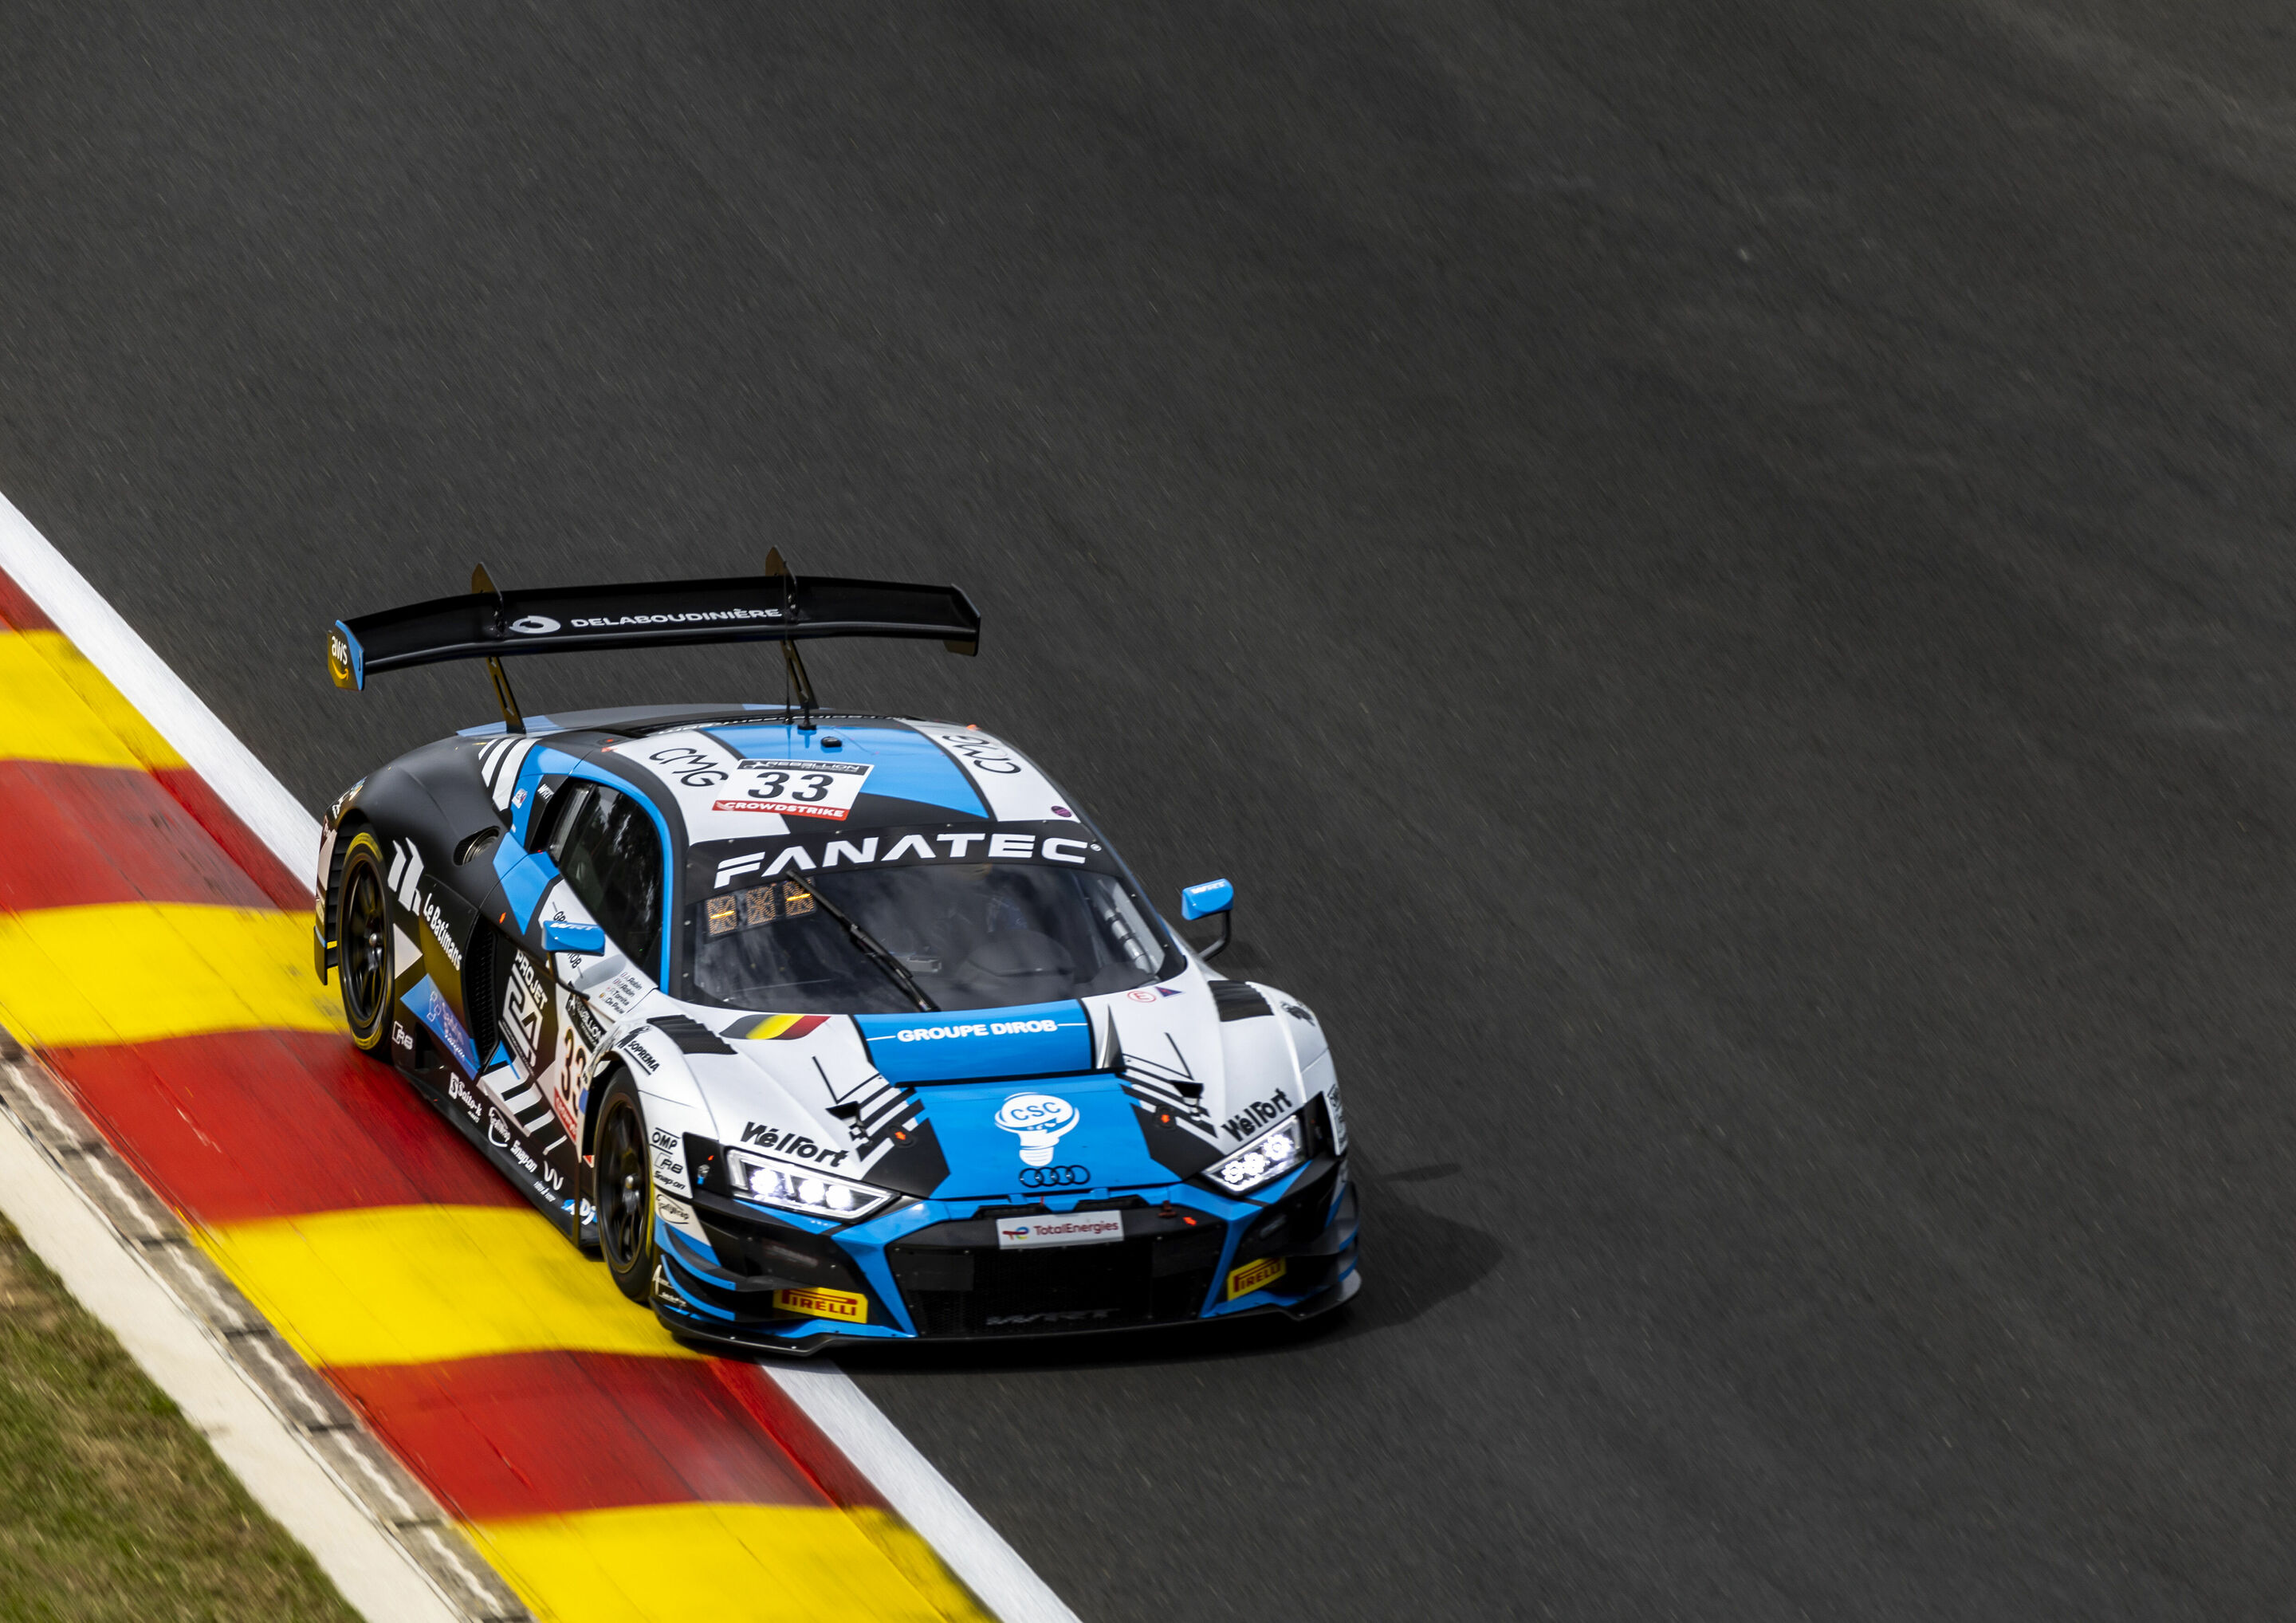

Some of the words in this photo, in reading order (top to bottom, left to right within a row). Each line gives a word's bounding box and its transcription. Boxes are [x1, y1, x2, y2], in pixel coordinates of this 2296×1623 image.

[571, 608, 782, 627] DELABOUDINIÈRE
[331, 635, 348, 666] aws
[649, 748, 729, 787] CMG
[942, 735, 1021, 774] CMG
[748, 772, 834, 802] 33
[725, 802, 845, 817] CROWDSTRIKE
[714, 833, 1087, 889] FANATEC
[423, 893, 434, 922] Le
[431, 906, 462, 971] Batimans
[515, 949, 548, 1010] PROJET
[897, 1024, 989, 1042] GROUPE
[990, 1020, 1058, 1035] DIROB
[627, 1040, 660, 1072] SOPREMA
[1011, 1102, 1061, 1120] CSC
[652, 1131, 678, 1149] OMP
[1033, 1221, 1119, 1235] TotalEnergies
[1233, 1257, 1282, 1294] PIRELLI
[781, 1288, 858, 1316] PIRELLI
